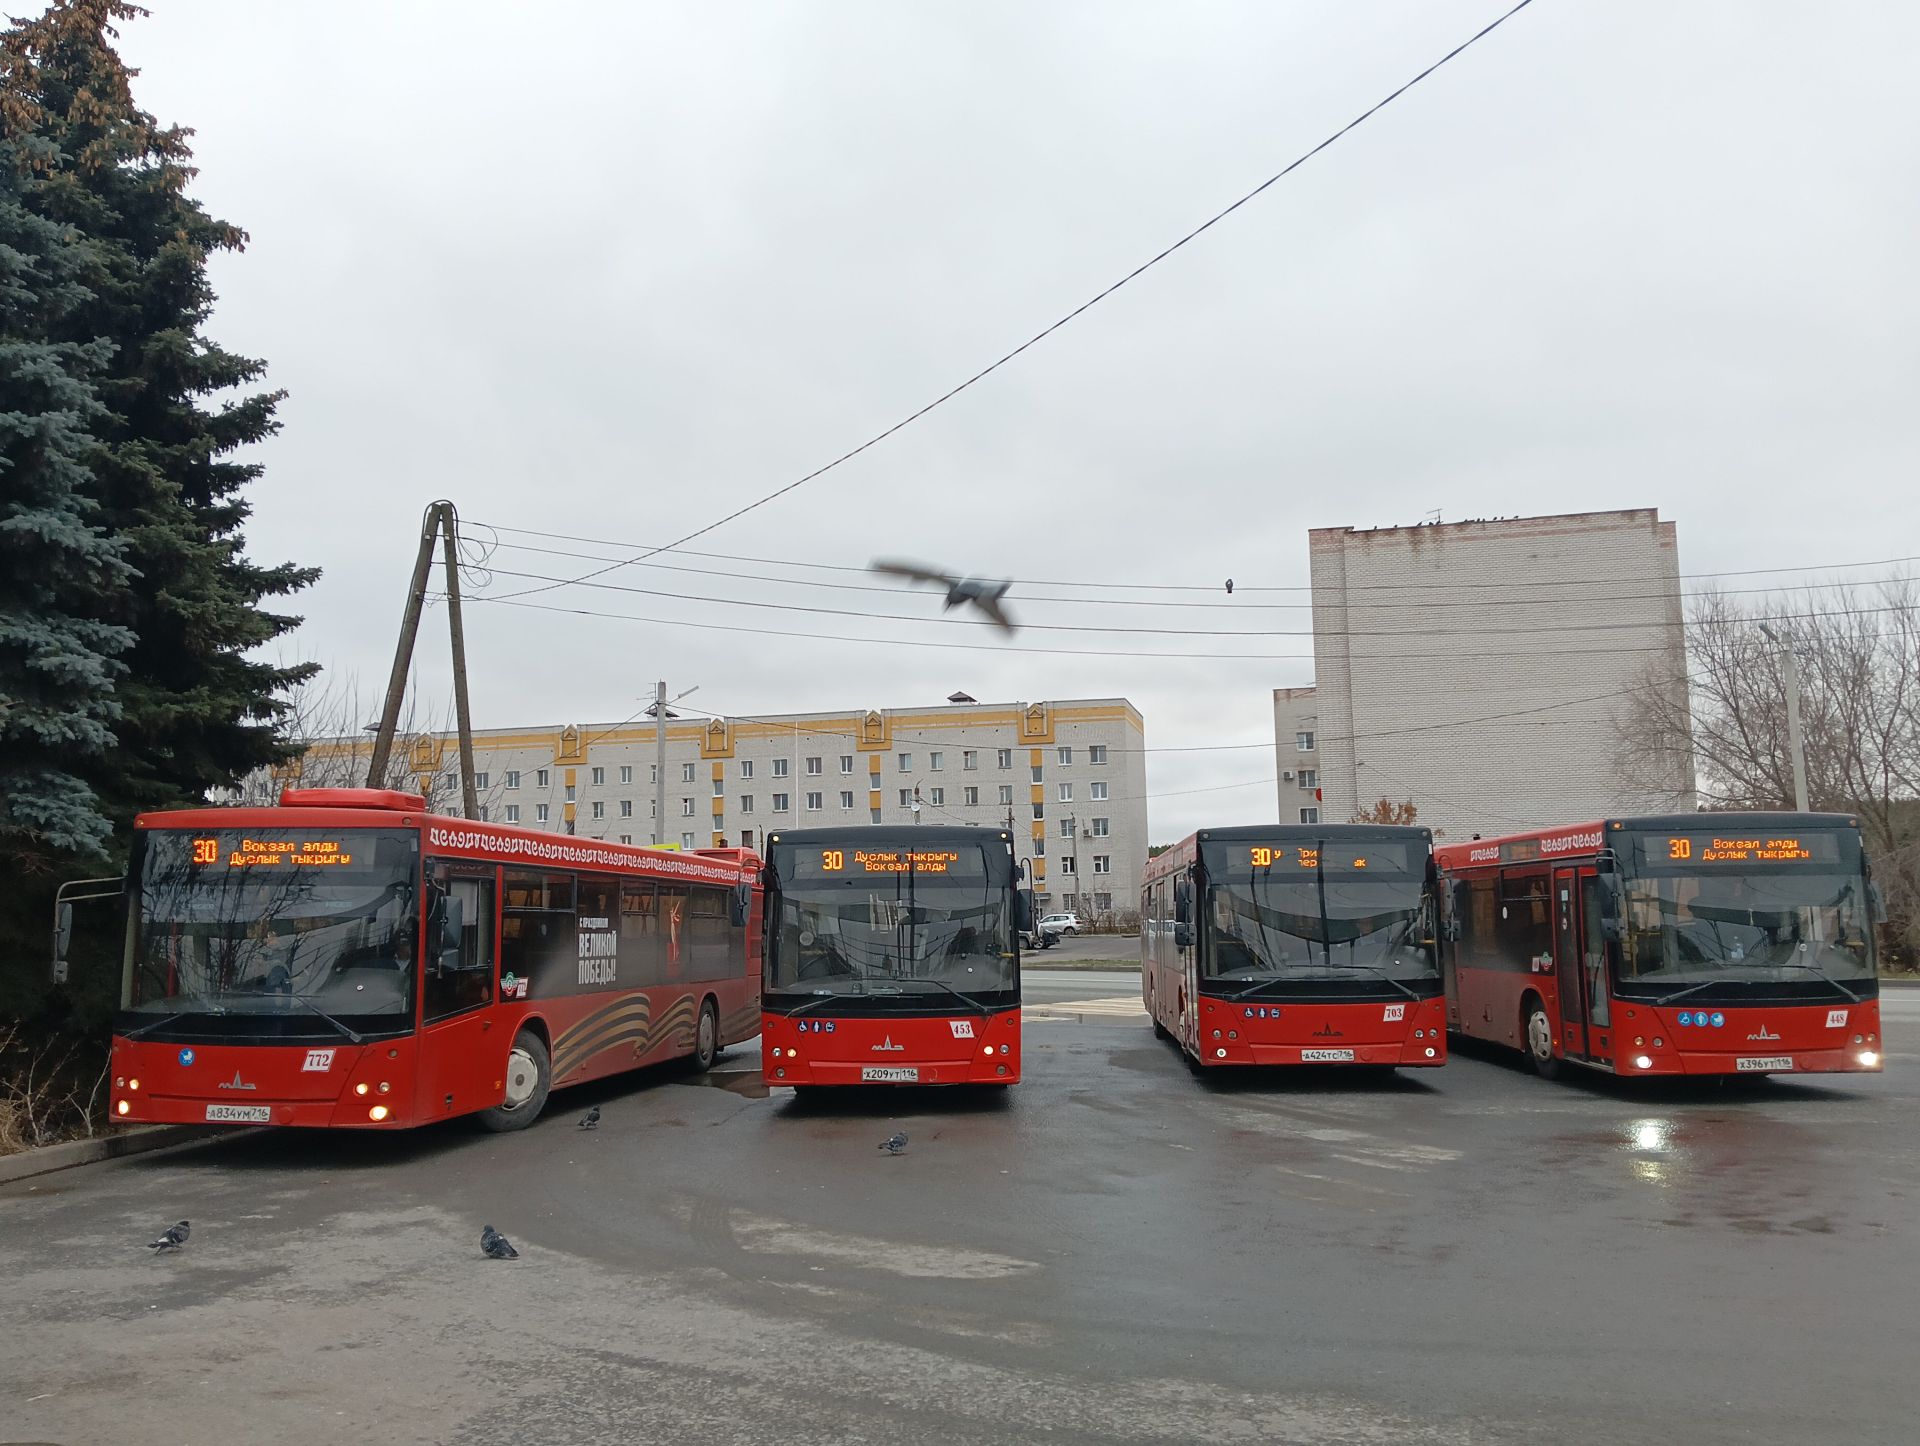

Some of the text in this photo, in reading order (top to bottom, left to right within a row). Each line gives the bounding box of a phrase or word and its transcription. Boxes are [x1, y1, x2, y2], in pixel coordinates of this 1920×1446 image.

[242, 839, 338, 853] Вокзал алды
[1669, 839, 1691, 859] 30
[1713, 838, 1760, 849] Вокзал
[193, 839, 216, 863] 30
[854, 850, 957, 863] Дуслык тыкрыгы
[1251, 848, 1271, 867] 30
[1702, 849, 1809, 860] Дуслык тыкрыгы
[229, 851, 350, 866] Дуслык тыкрыгы
[822, 851, 843, 870] 30
[865, 861, 947, 872] Вокзал алды
[578, 930, 617, 957] ВЕЛИКОЙ
[578, 958, 617, 986] ПОБЕДЫ!
[1386, 1007, 1402, 1018] 703
[953, 1024, 971, 1035] 453
[308, 1054, 330, 1067] 772
